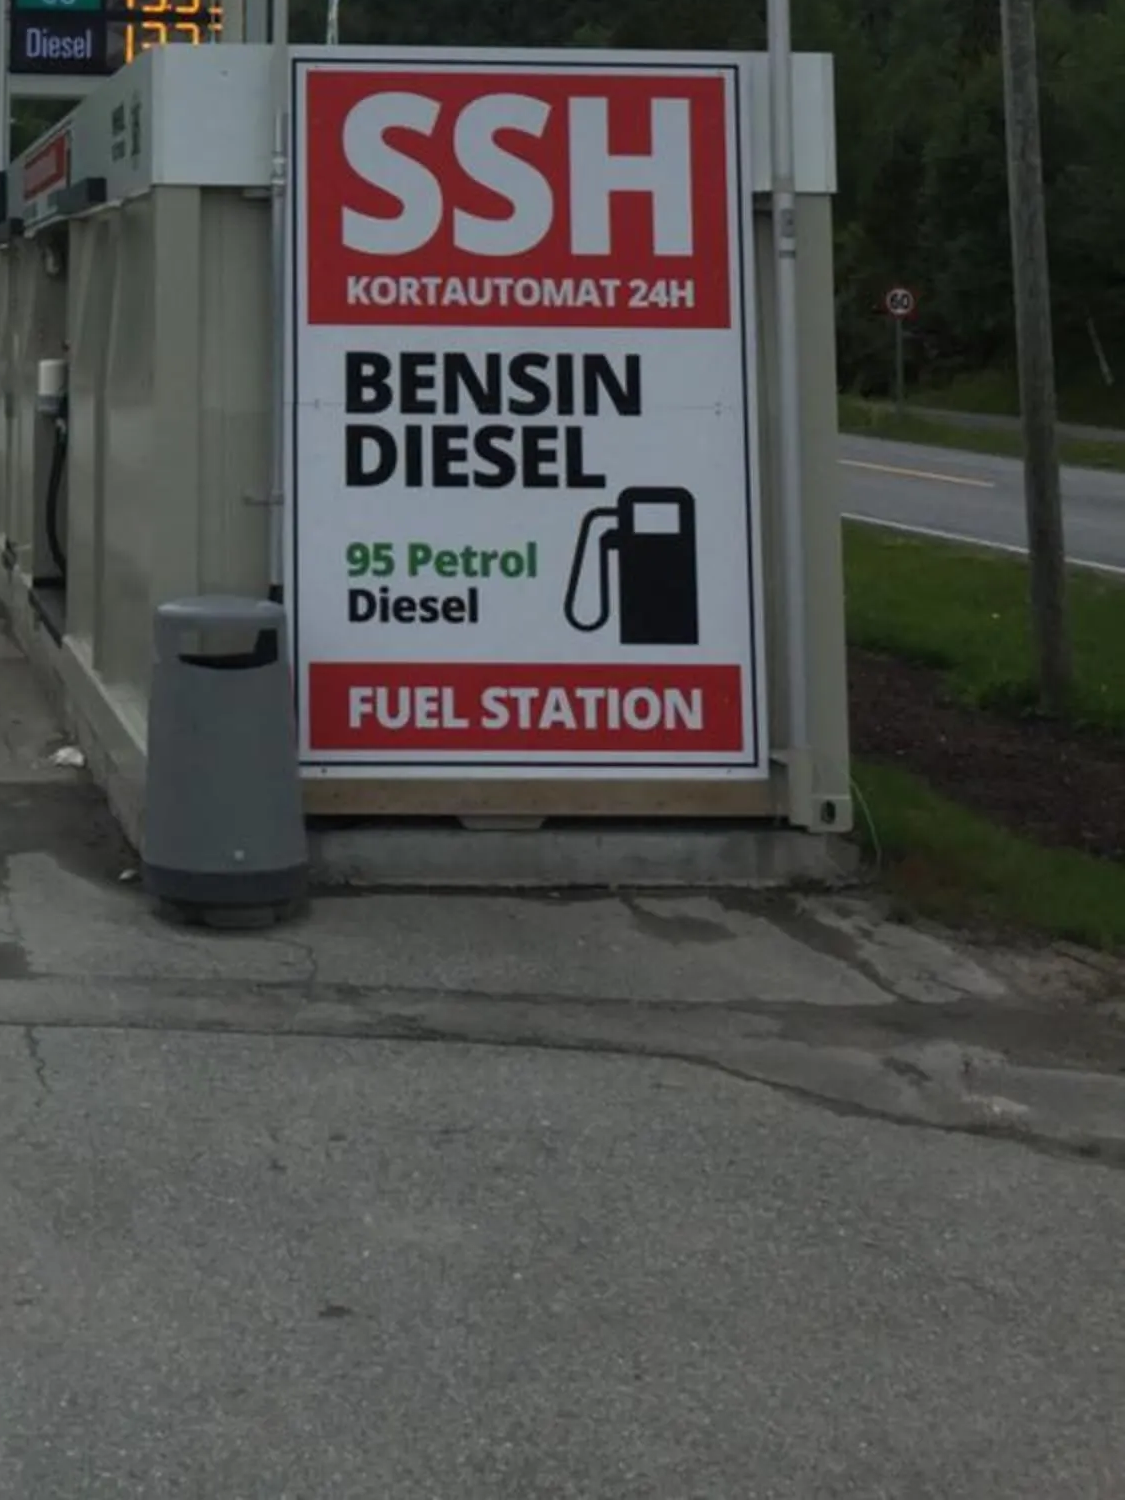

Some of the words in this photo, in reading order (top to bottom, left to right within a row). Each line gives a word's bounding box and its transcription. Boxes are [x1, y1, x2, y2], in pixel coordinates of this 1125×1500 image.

[26, 28, 92, 60] Diesel
[341, 91, 694, 257] SSH
[346, 275, 620, 308] KORTAUTOMAT
[627, 278, 695, 309] 24H
[345, 351, 642, 417] BENSIN
[345, 424, 607, 488] DIESEL
[346, 542, 395, 578] 95
[407, 542, 537, 578] Petrol
[348, 587, 479, 624] Diesel
[348, 686, 470, 729] FUEL
[480, 686, 705, 731] STATION
